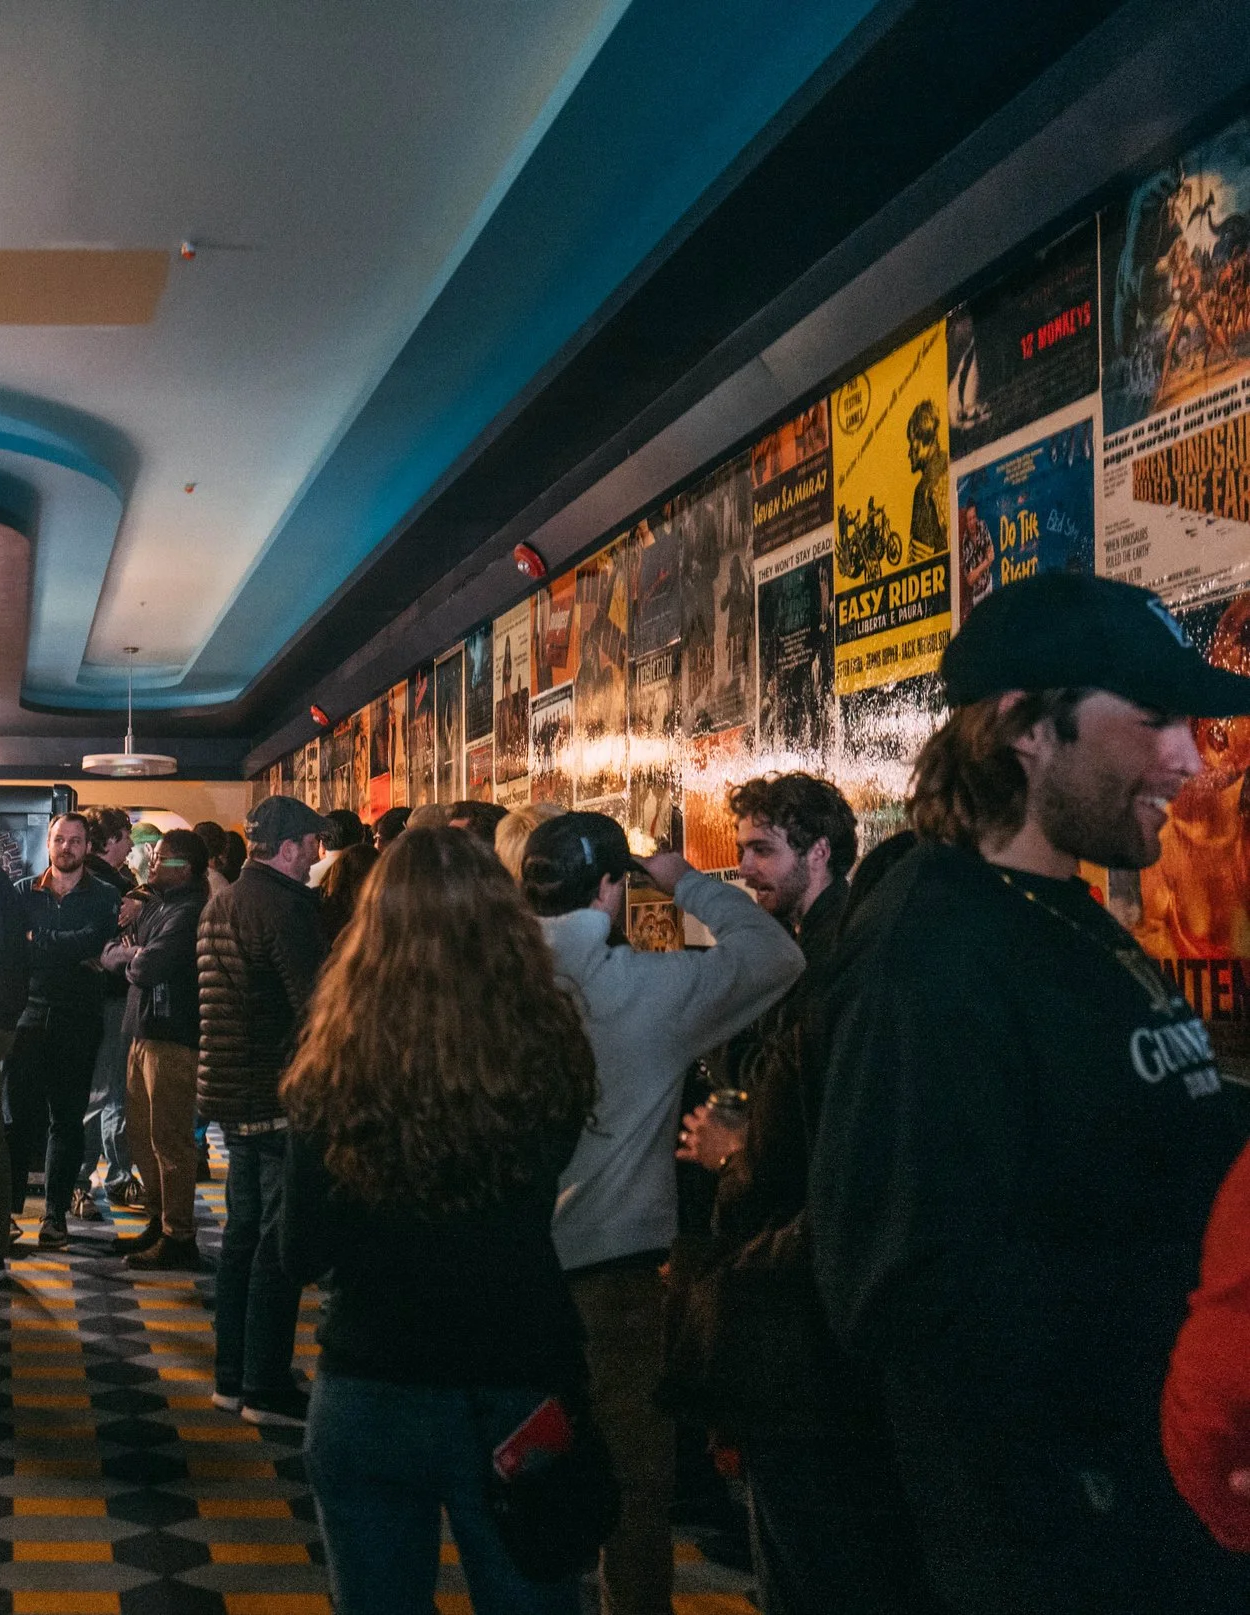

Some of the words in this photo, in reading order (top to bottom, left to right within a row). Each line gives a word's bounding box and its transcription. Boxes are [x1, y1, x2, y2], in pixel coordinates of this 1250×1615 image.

[1103, 432, 1129, 452] Enter
[1132, 426, 1144, 440] an
[1147, 417, 1167, 432] age
[1170, 407, 1181, 422] of
[1184, 384, 1238, 416] unknown
[1103, 446, 1134, 469] pagan
[1136, 425, 1181, 452] worship
[1183, 413, 1204, 432] and
[1207, 398, 1242, 421] virgin
[1177, 471, 1208, 514] THE
[758, 564, 773, 582] THEY
[774, 555, 794, 573] WON'T
[795, 546, 812, 565] STAY
[1123, 549, 1131, 563] THE
[839, 585, 884, 626] EASY
[889, 564, 946, 609] RIDER
[890, 611, 896, 626] E
[902, 640, 916, 661] JACK
